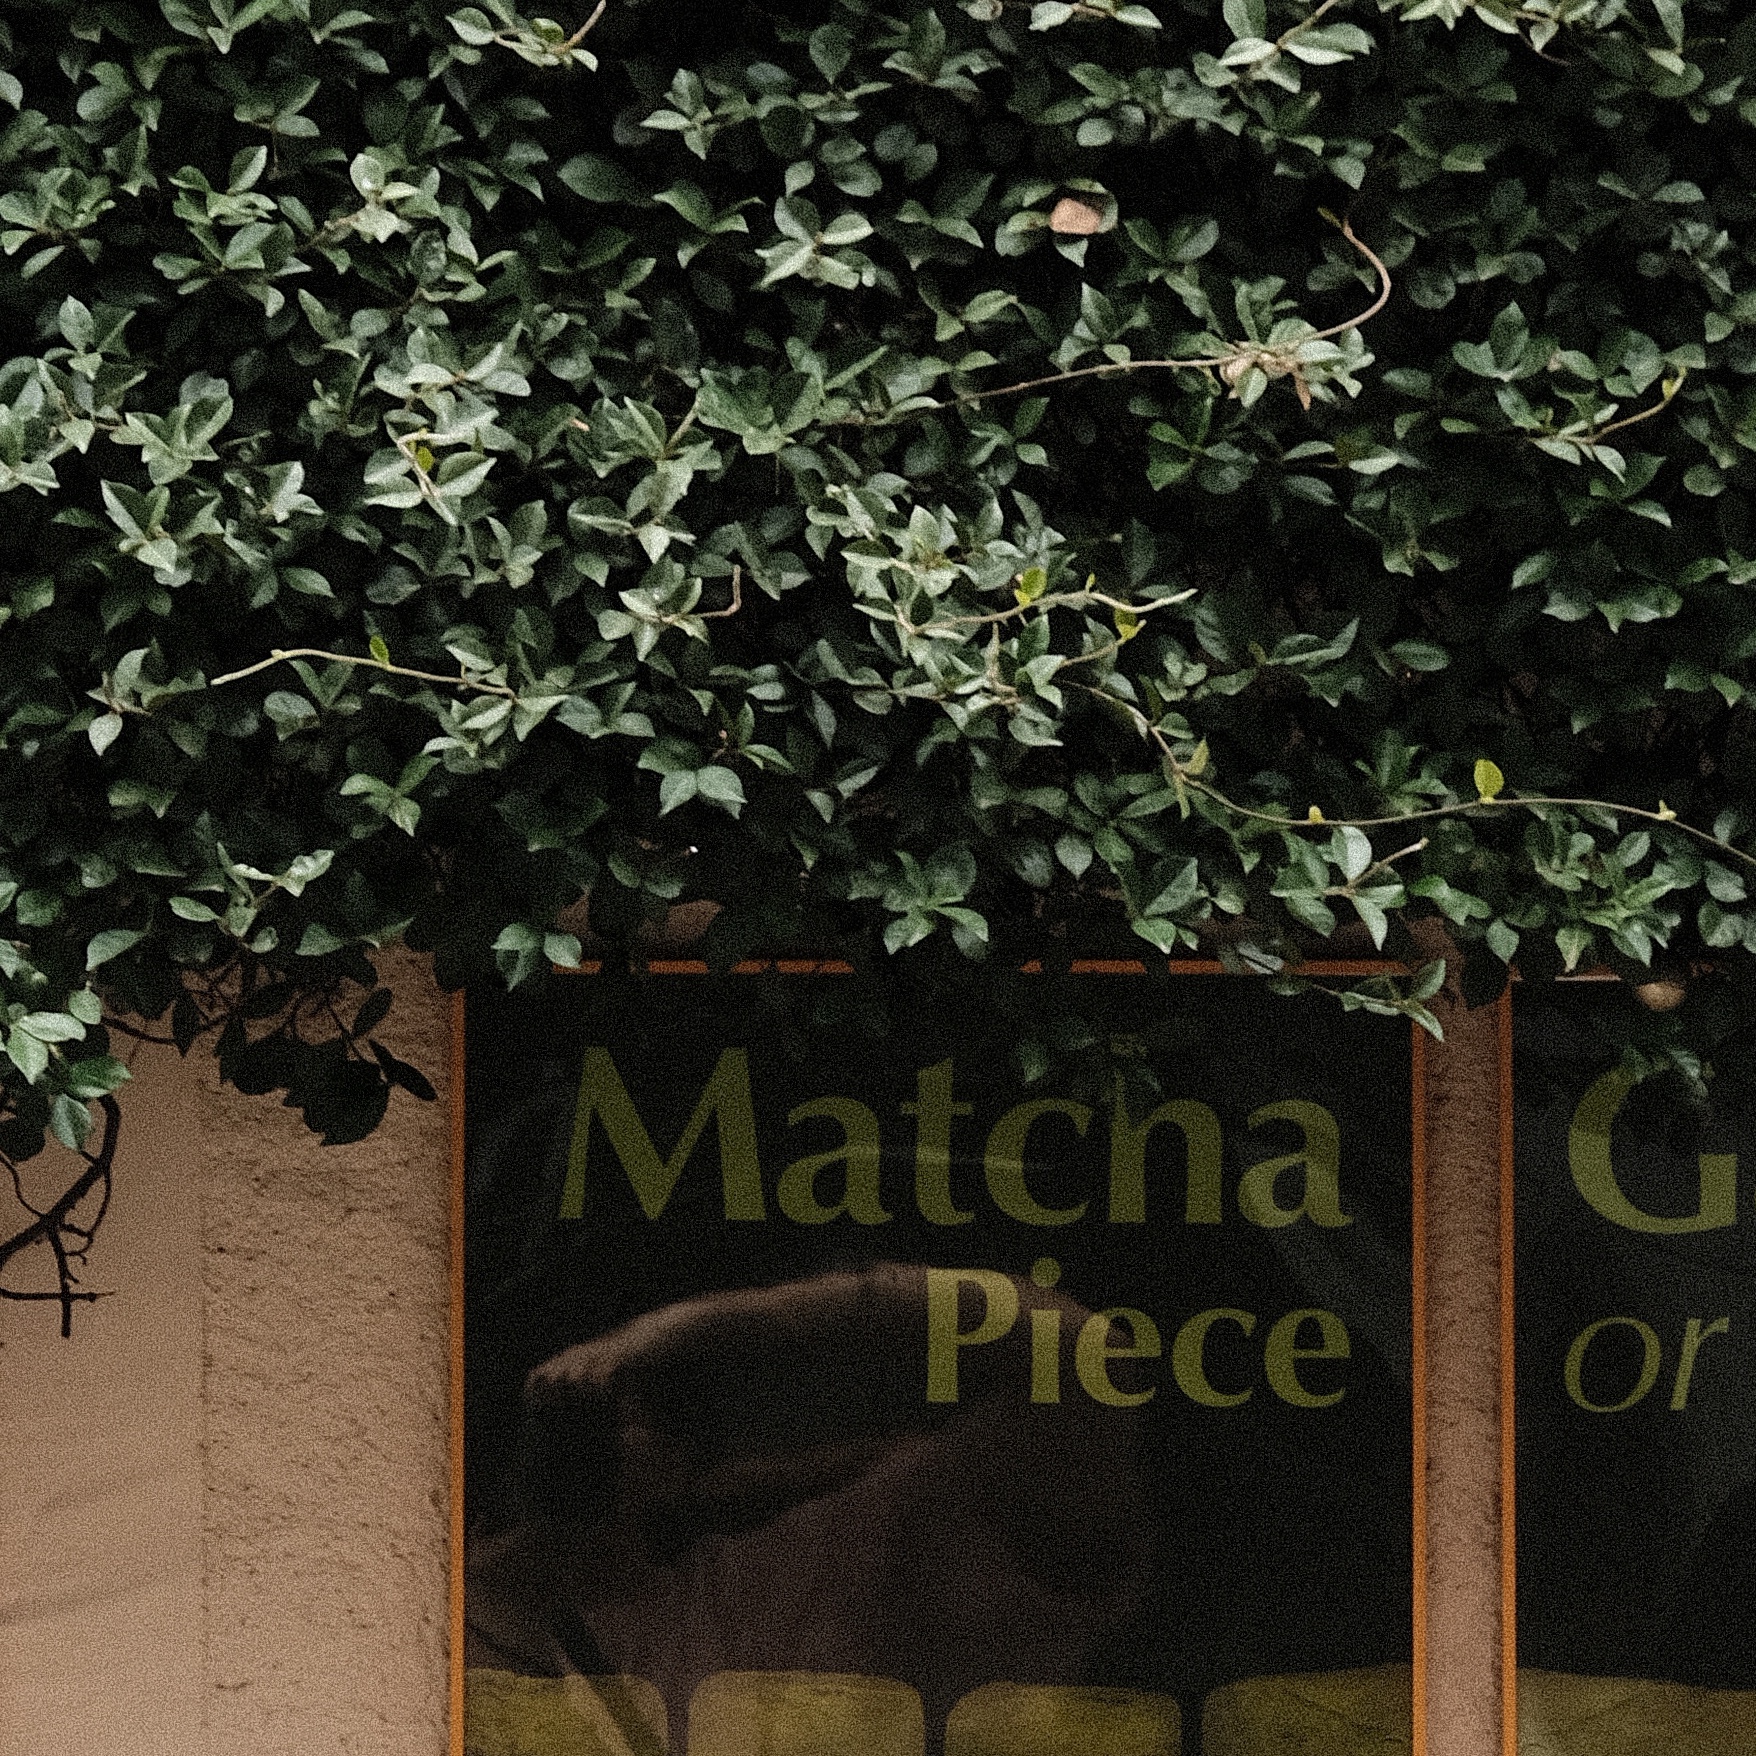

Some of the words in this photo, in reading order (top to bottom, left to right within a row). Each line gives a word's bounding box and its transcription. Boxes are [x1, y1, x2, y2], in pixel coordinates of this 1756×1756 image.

[557, 1036, 1354, 1229] Matcha
[925, 1257, 1353, 1409] Piece
[1563, 1316, 1730, 1414] or
